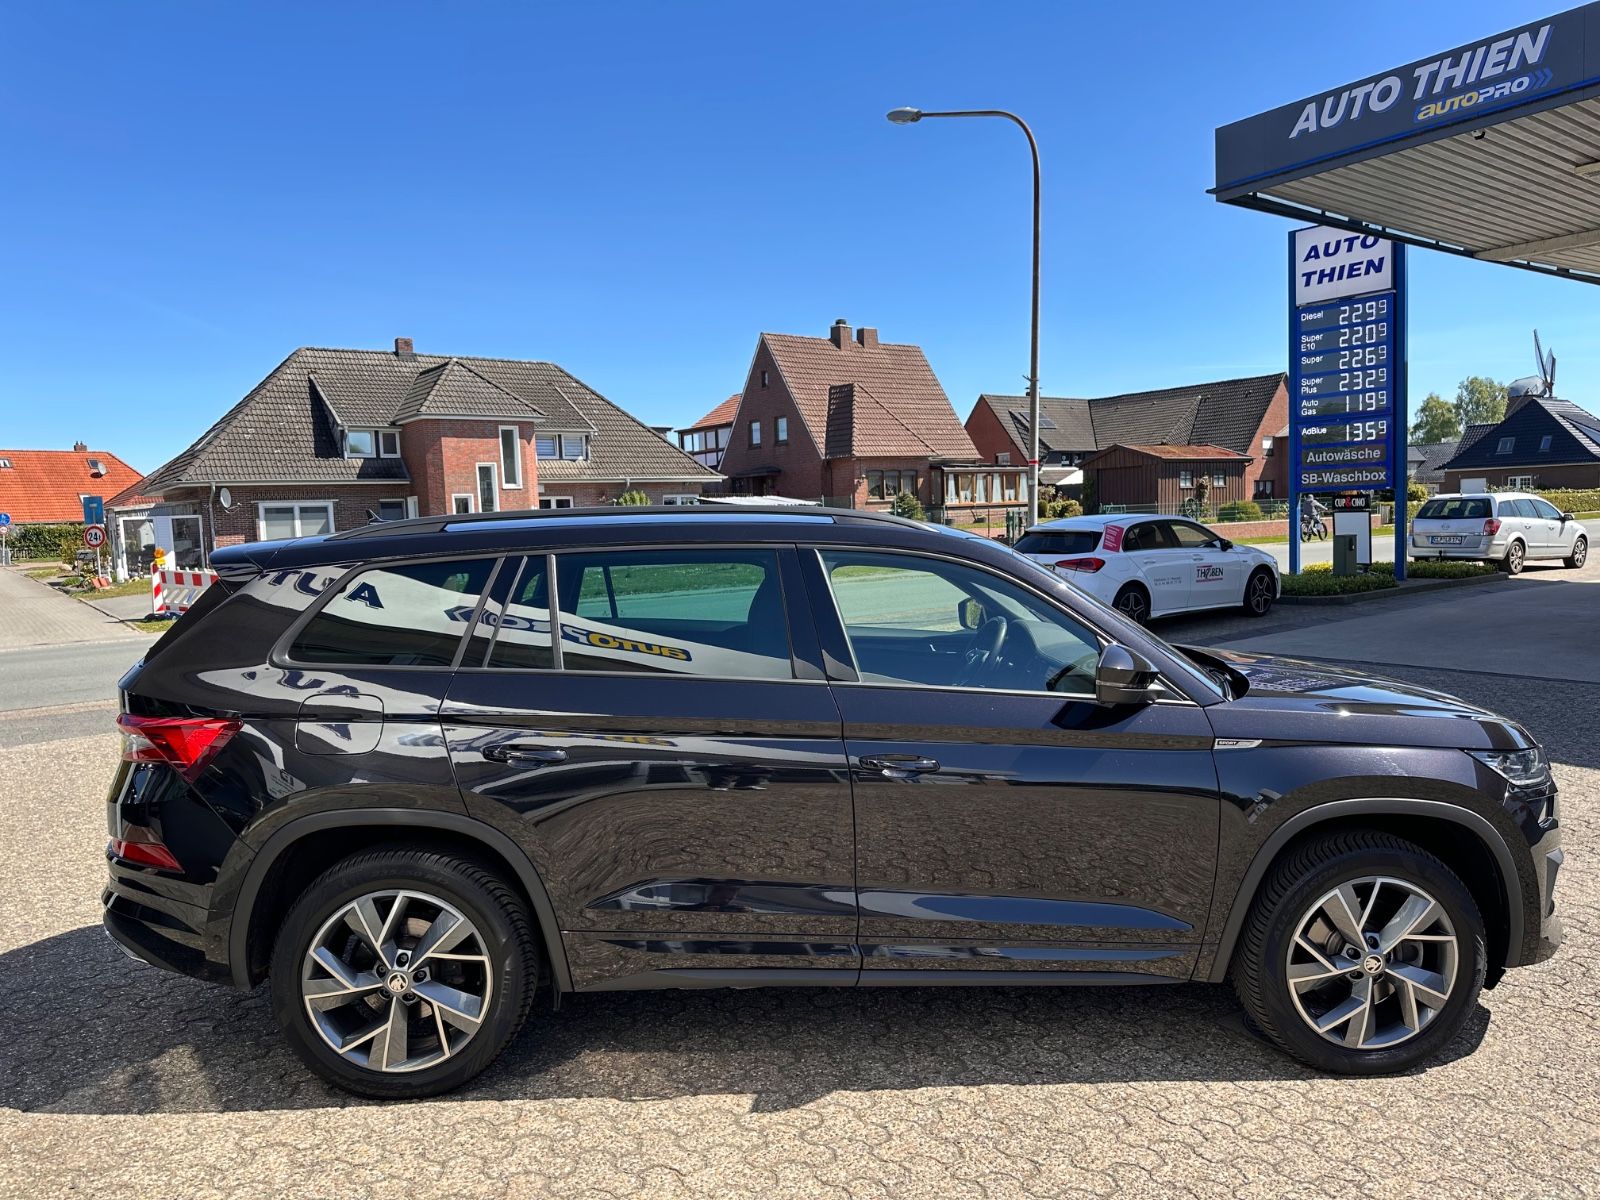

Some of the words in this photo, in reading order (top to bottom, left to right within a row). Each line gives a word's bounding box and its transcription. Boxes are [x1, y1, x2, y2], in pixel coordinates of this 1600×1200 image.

[1289, 76, 1402, 139] AUTO
[1413, 25, 1551, 100] THIEN
[1302, 234, 1380, 262] AUTO
[1301, 256, 1385, 287] THIEN
[1301, 311, 1324, 321] Diesel
[1301, 333, 1324, 343] Super
[1301, 342, 1316, 351] E10
[1301, 355, 1324, 365] Super
[1301, 377, 1324, 387] Super
[1301, 386, 1317, 395] Plus
[1301, 399, 1319, 408] Auto
[1301, 408, 1317, 416] Gas
[1301, 427, 1327, 436] AdBlue
[1307, 447, 1381, 463] Autowäsche
[1301, 470, 1386, 485] SB-Waschbox
